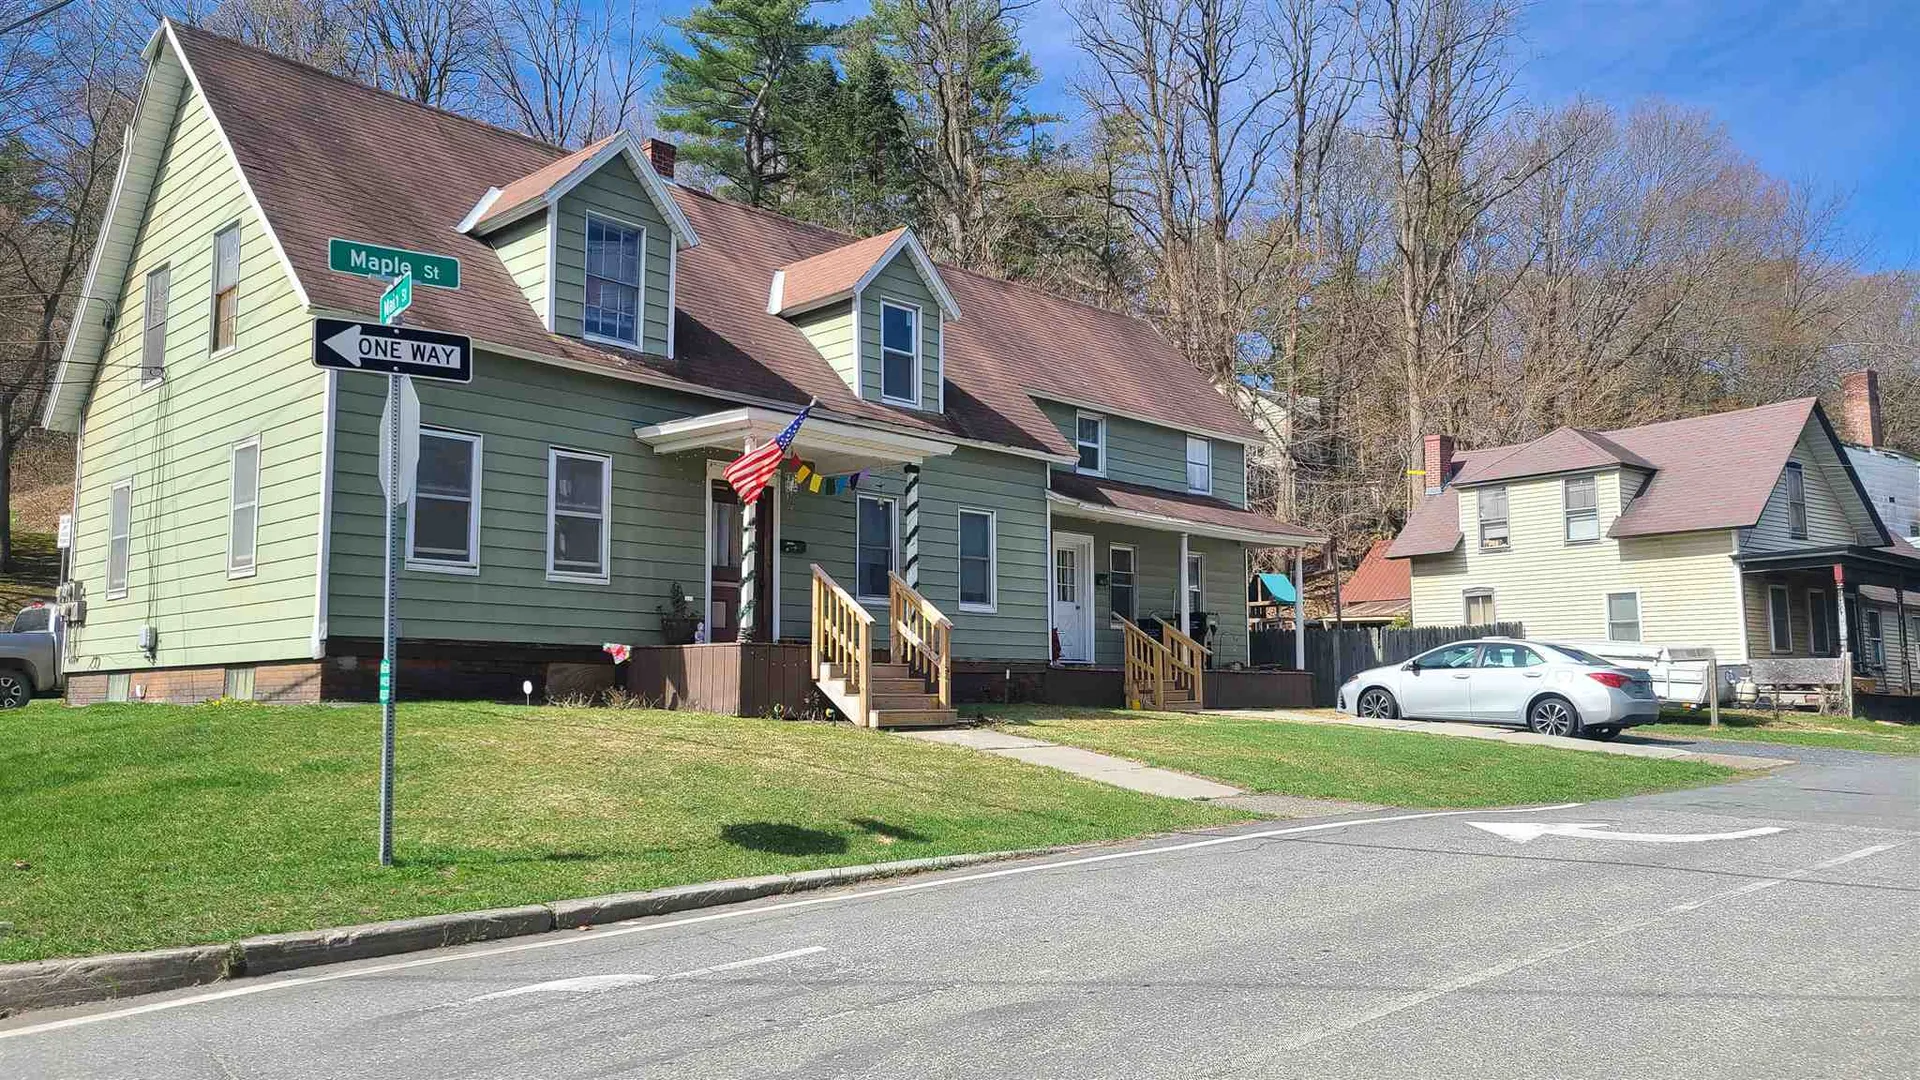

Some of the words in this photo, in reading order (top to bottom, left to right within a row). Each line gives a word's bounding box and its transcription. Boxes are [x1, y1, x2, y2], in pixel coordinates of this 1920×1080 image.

[350, 249, 411, 275] Maple
[424, 265, 440, 280] St
[359, 338, 402, 359] ONE
[411, 344, 455, 365] WAY
